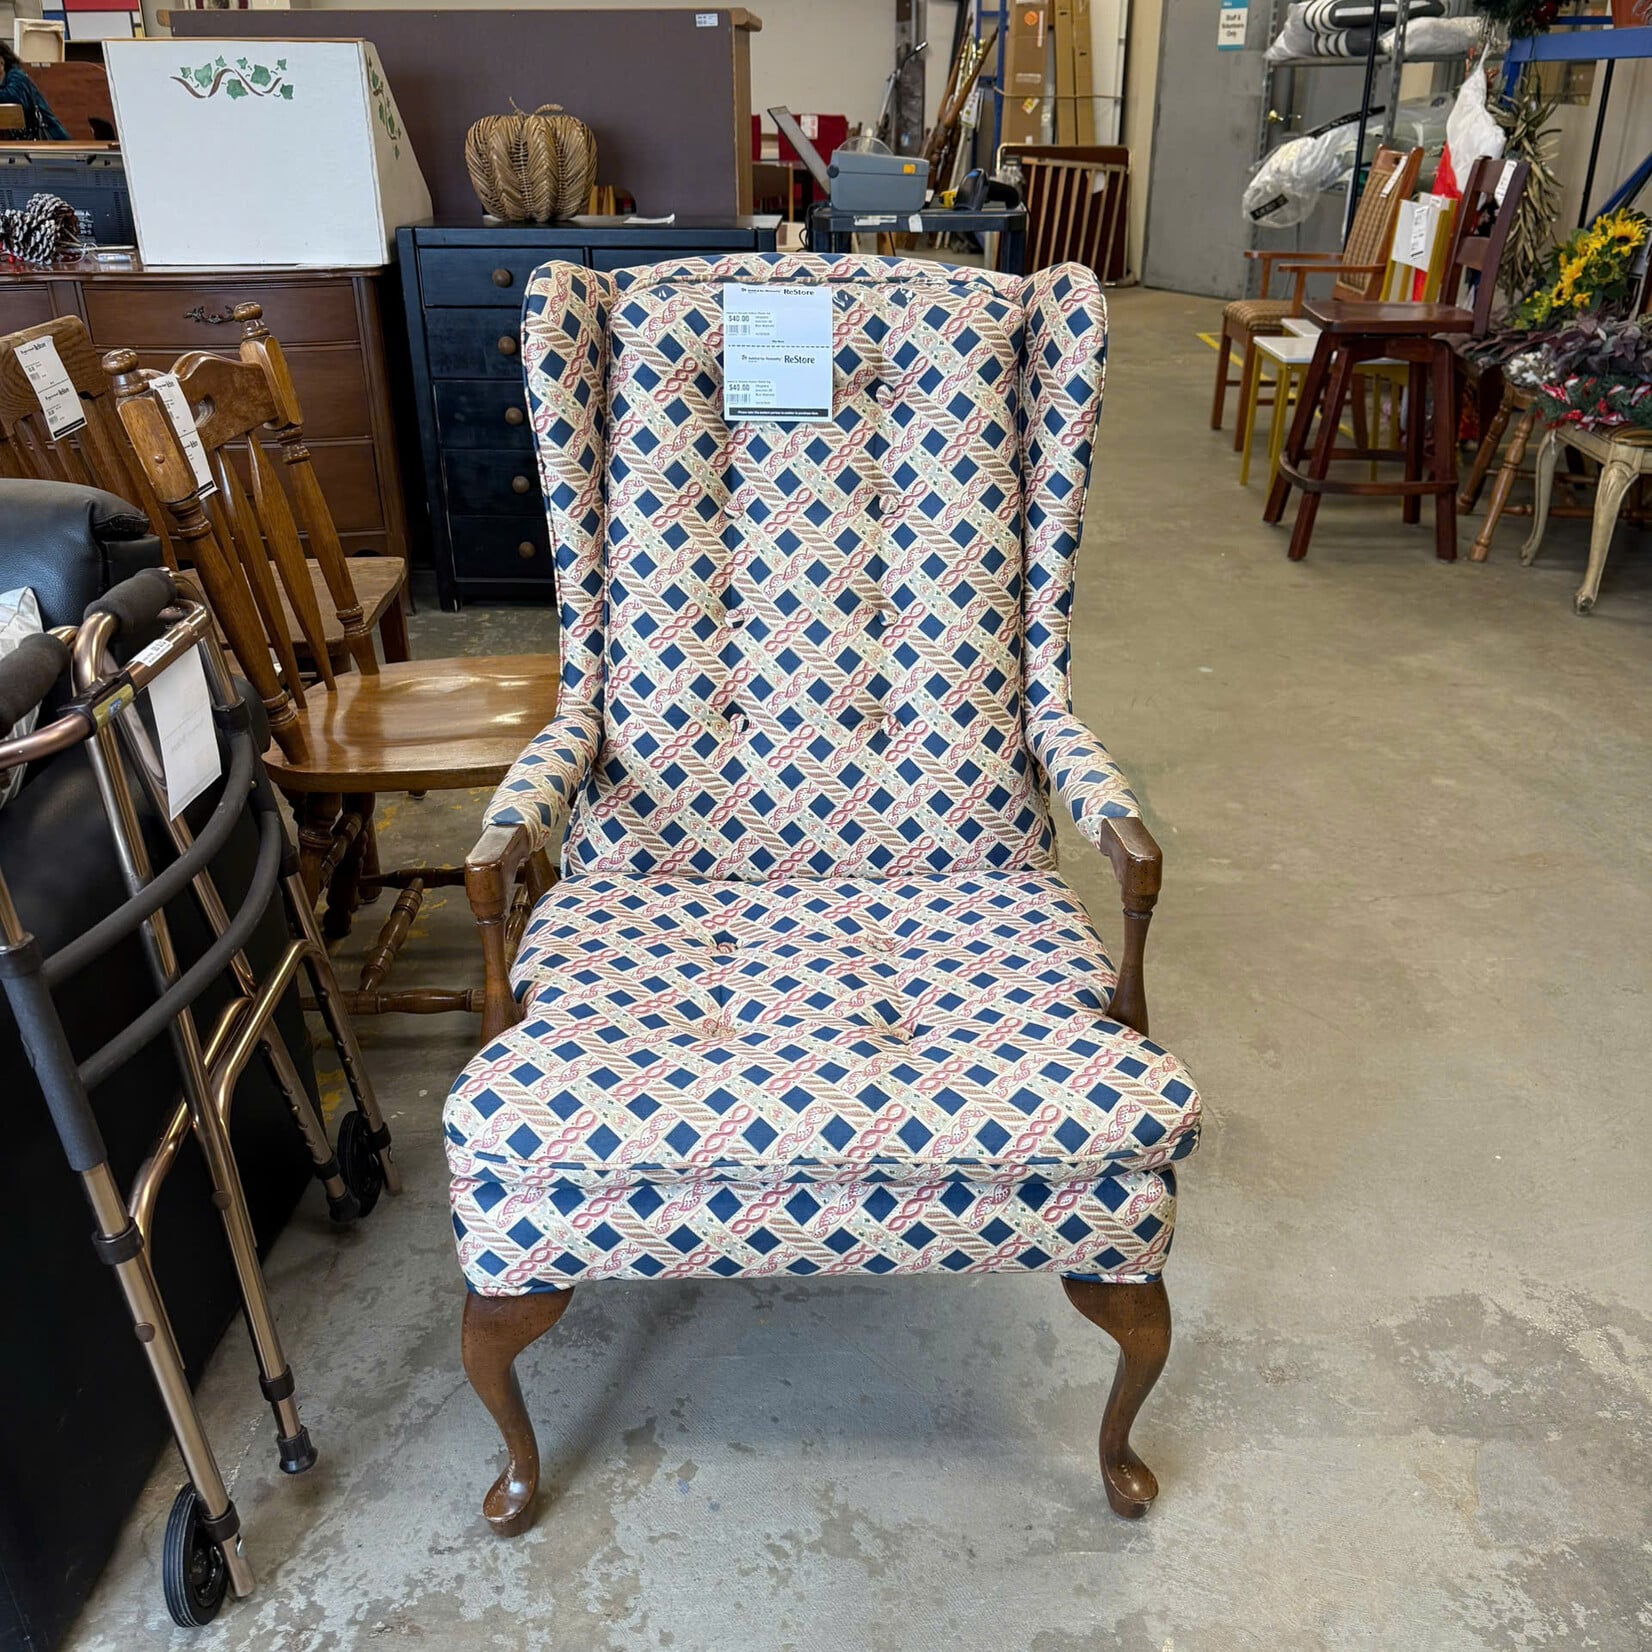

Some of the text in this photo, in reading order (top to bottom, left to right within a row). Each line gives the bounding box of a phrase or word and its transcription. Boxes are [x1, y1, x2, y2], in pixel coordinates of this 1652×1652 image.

[783, 288, 815, 296] ReStore
[784, 354, 816, 364] ReStore
[728, 383, 750, 391] $40.00
